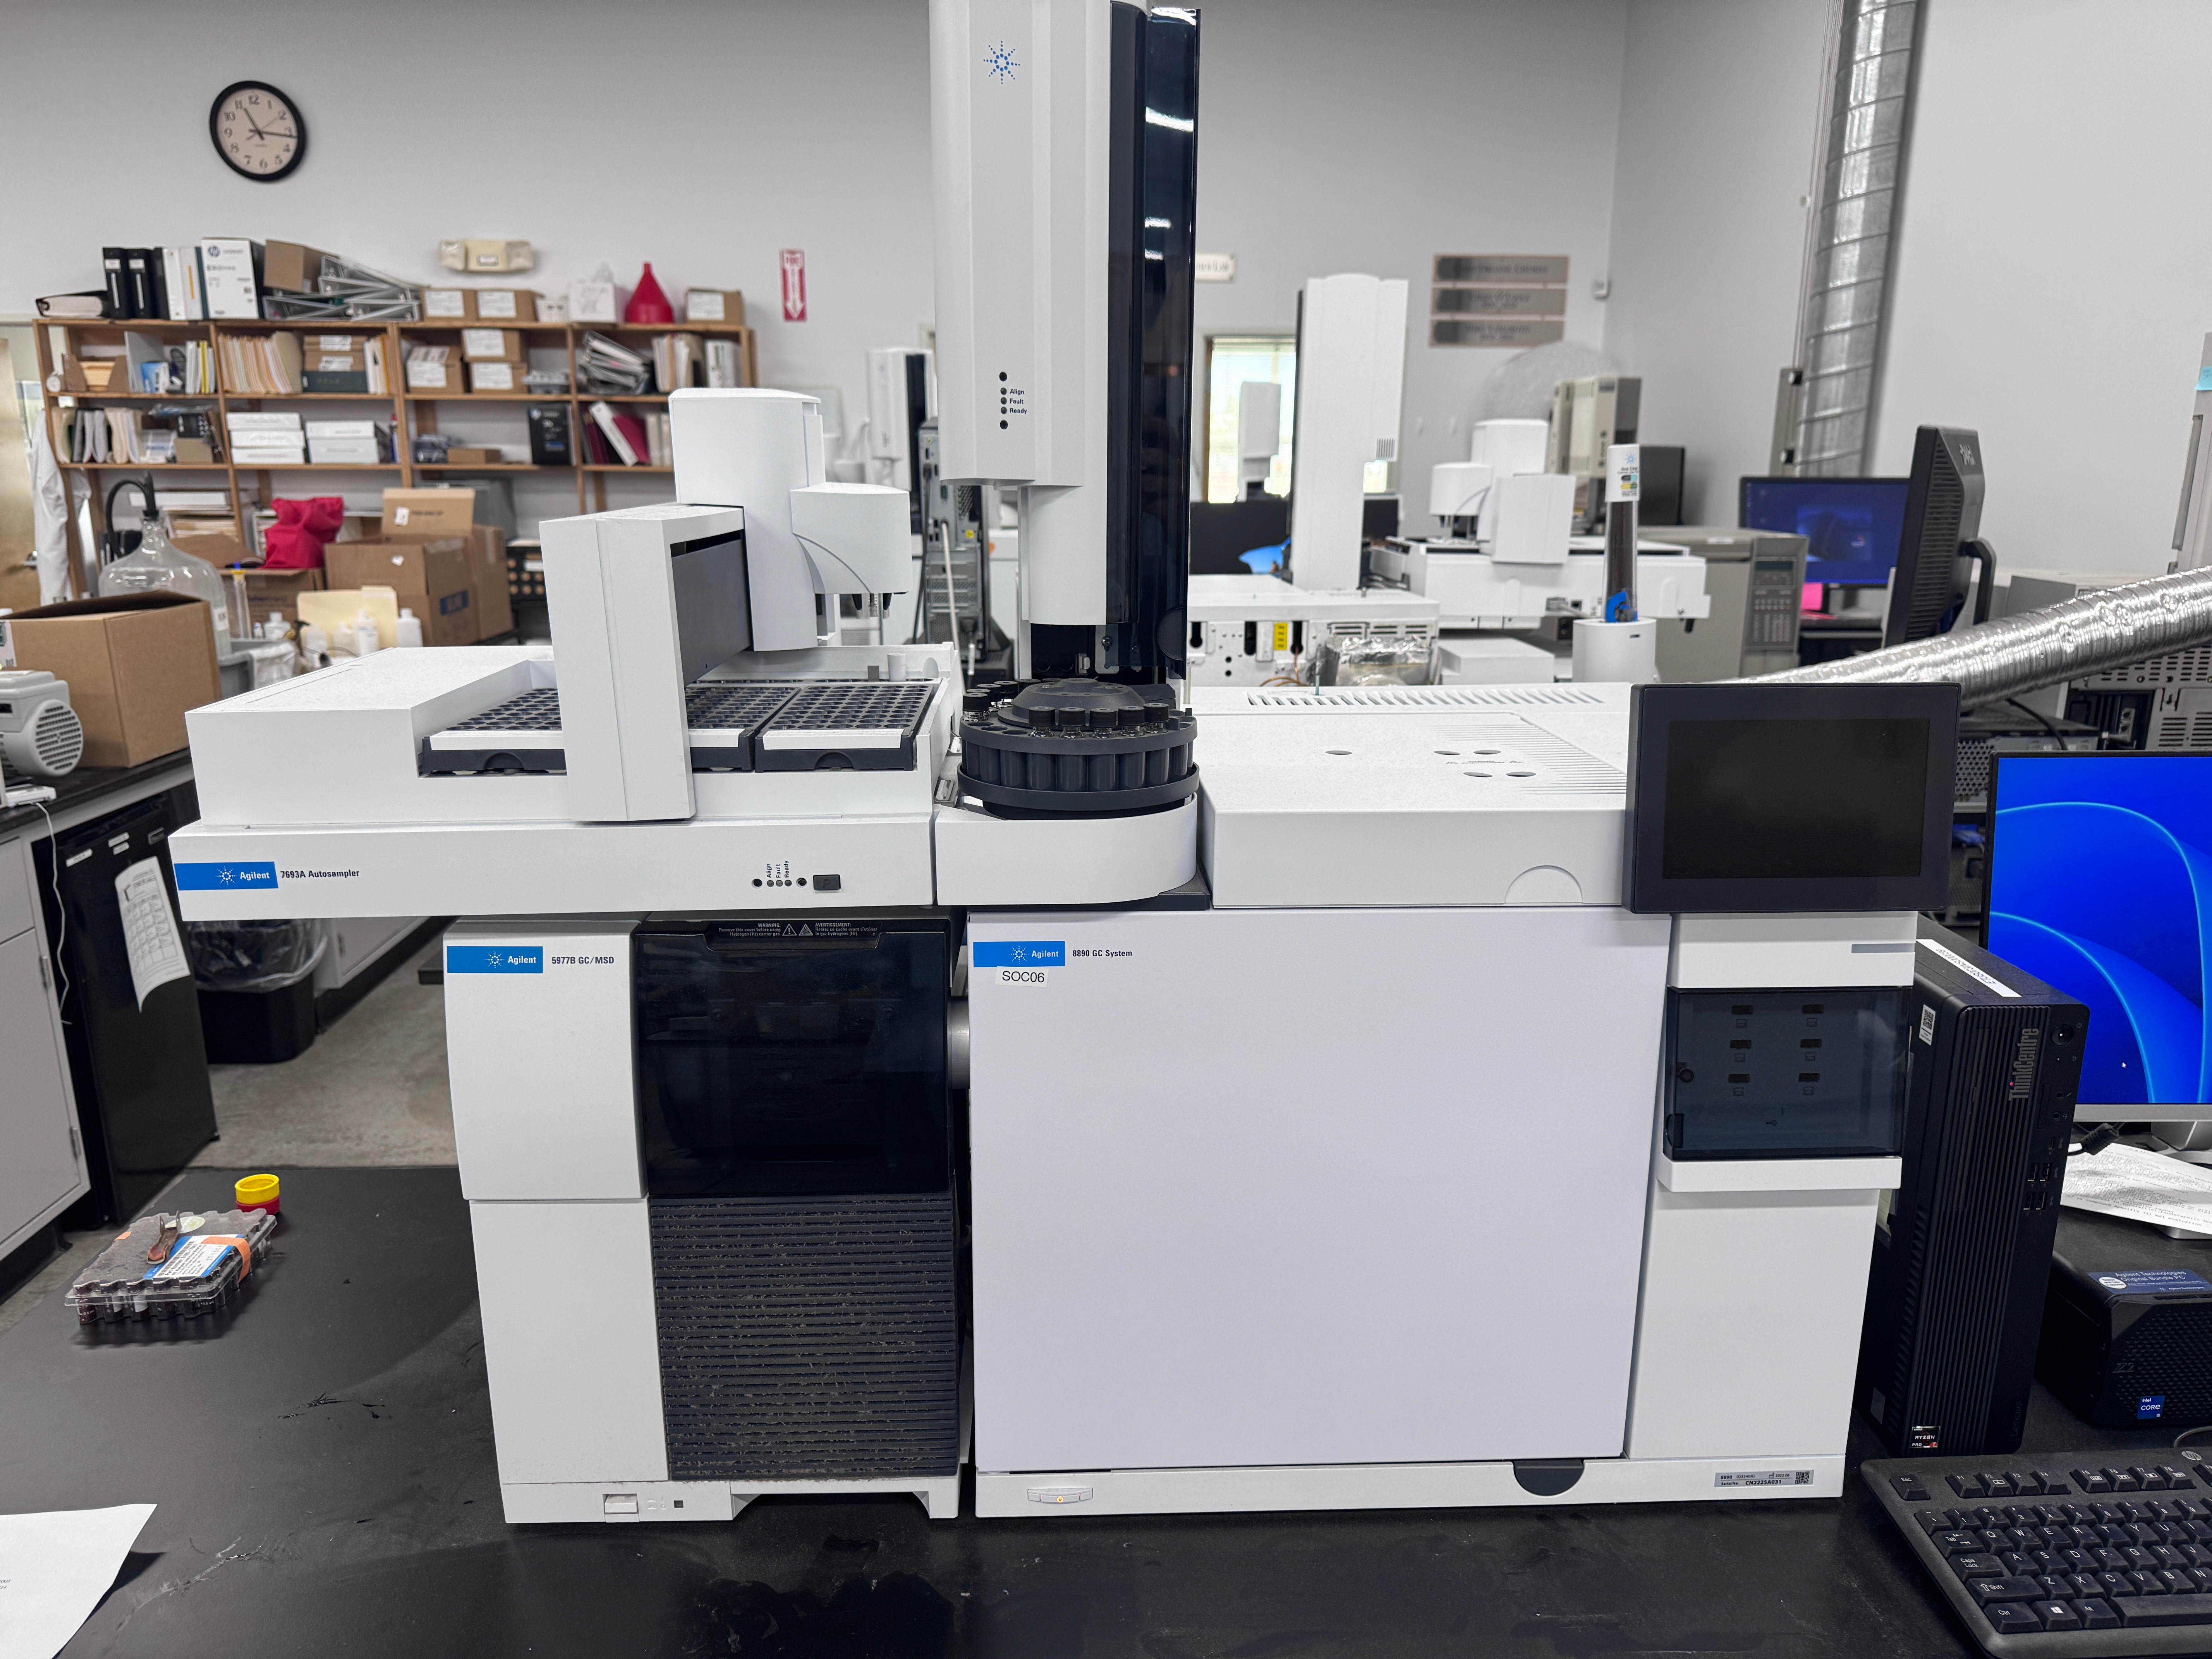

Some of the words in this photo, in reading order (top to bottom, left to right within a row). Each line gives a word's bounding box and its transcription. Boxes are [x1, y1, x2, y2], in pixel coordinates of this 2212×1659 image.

[235, 100, 243, 109] 11
[248, 94, 259, 105] 12
[267, 100, 272, 110] 1
[224, 111, 235, 122] 10
[278, 110, 287, 120] 2
[224, 127, 232, 137] 9
[231, 142, 239, 154] 8
[283, 143, 290, 153] 4
[244, 155, 252, 165] 7
[259, 158, 268, 169] 6
[275, 155, 283, 165] 5
[240, 871, 270, 881] Agilent
[280, 870, 306, 879] 7693A
[308, 869, 359, 878] Autosampler
[1031, 950, 1059, 959] Agilent
[1105, 950, 1132, 958] System
[508, 956, 537, 965] Agilent
[578, 956, 614, 965] GC/MSD
[1002, 971, 1044, 982] SOC06
[2008, 1028, 2039, 1101] ThinkCentre
[2133, 1572, 2144, 1580] V
